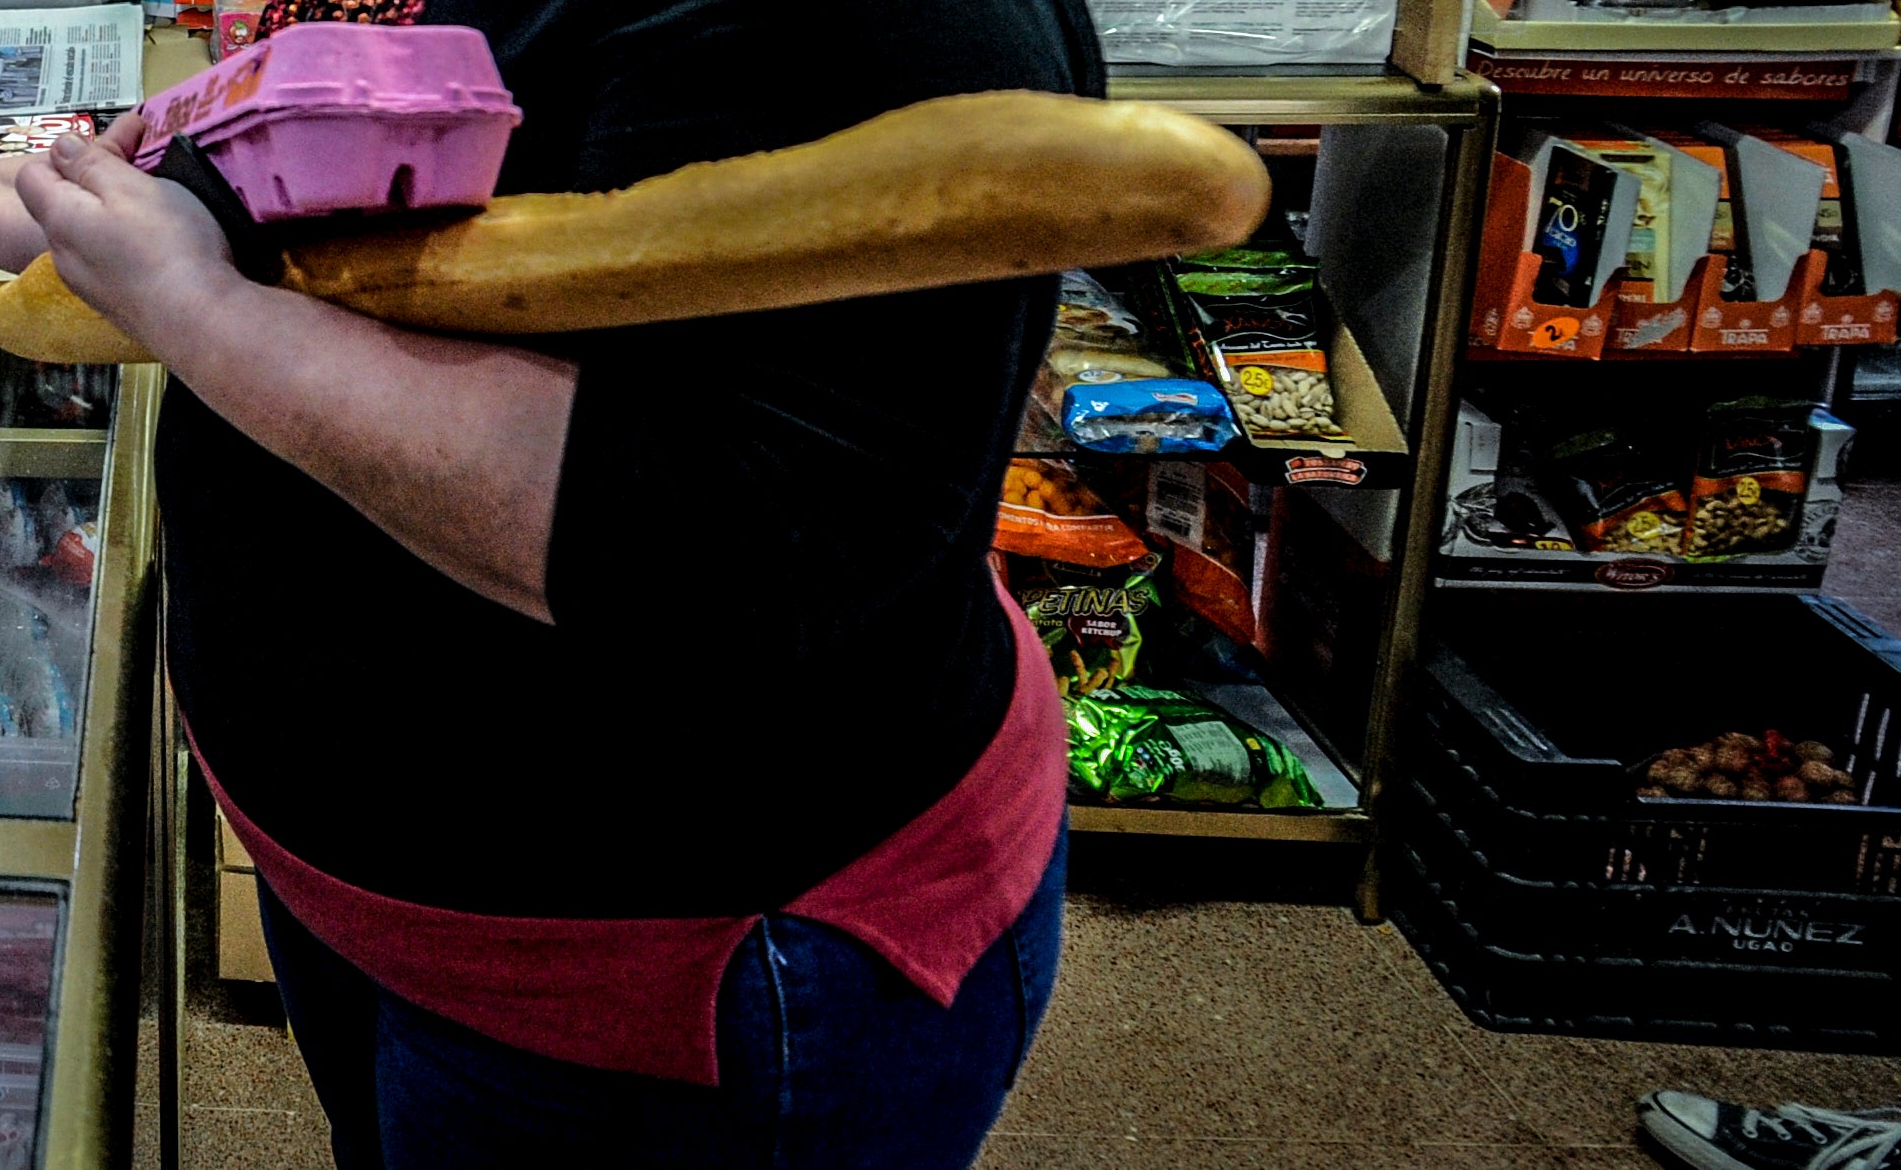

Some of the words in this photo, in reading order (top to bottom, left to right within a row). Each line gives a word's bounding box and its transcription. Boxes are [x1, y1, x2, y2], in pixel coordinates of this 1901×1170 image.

[1475, 58, 1571, 81] Descubre
[1582, 66, 1610, 81] un
[1620, 63, 1714, 85] universo
[1724, 65, 1749, 85] de
[1759, 68, 1849, 87] sabores
[1711, 331, 1768, 345] TRAPA
[1085, 620, 1117, 629] SABOR
[1081, 627, 1123, 637] KETCHUP
